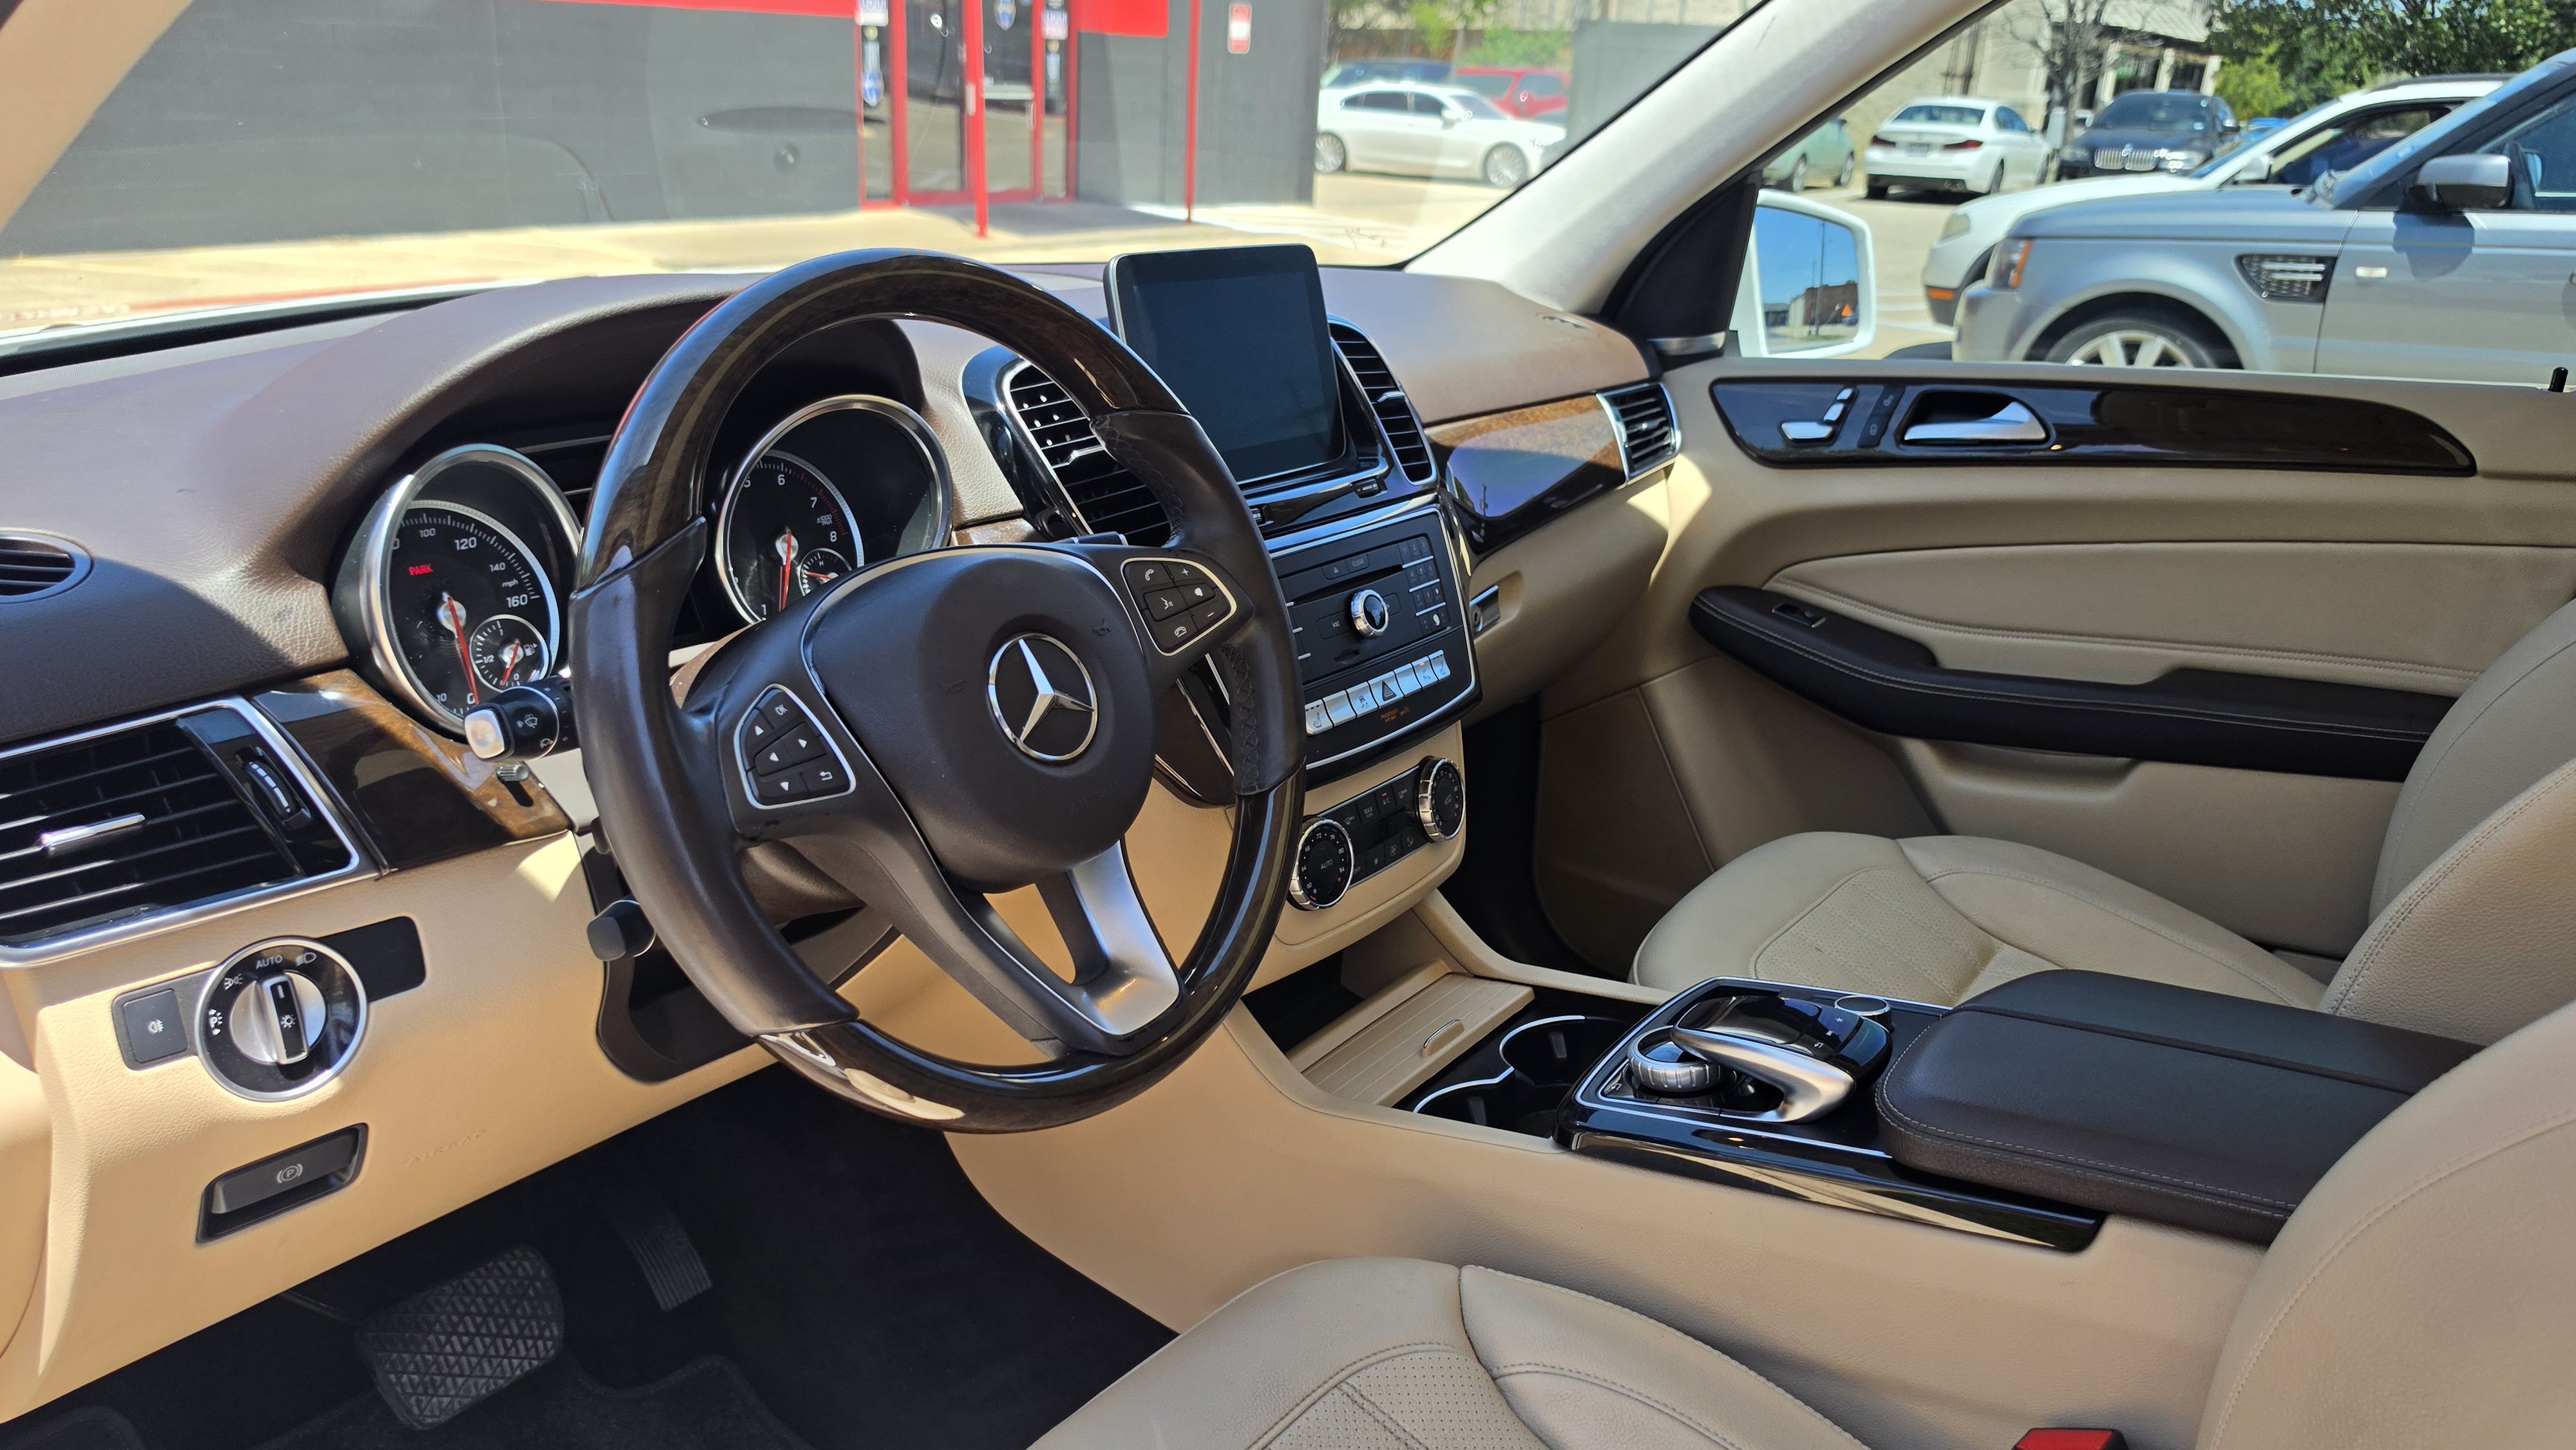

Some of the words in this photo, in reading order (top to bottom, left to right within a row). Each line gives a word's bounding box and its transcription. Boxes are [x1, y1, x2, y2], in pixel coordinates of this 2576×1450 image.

[778, 474, 785, 485] 6
[810, 496, 817, 508] 7
[419, 528, 436, 538] 100
[830, 531, 837, 542] 8
[454, 537, 477, 551] 120
[408, 563, 433, 576] PARK
[489, 562, 506, 572] 140
[502, 579, 518, 588] mph
[506, 594, 528, 608] 160
[761, 604, 767, 616] 1
[484, 654, 495, 663] 1/2
[467, 693, 476, 704] 0
[775, 704, 788, 716] OK
[1320, 859, 1334, 870] AUTO
[256, 955, 283, 969] AUTO
